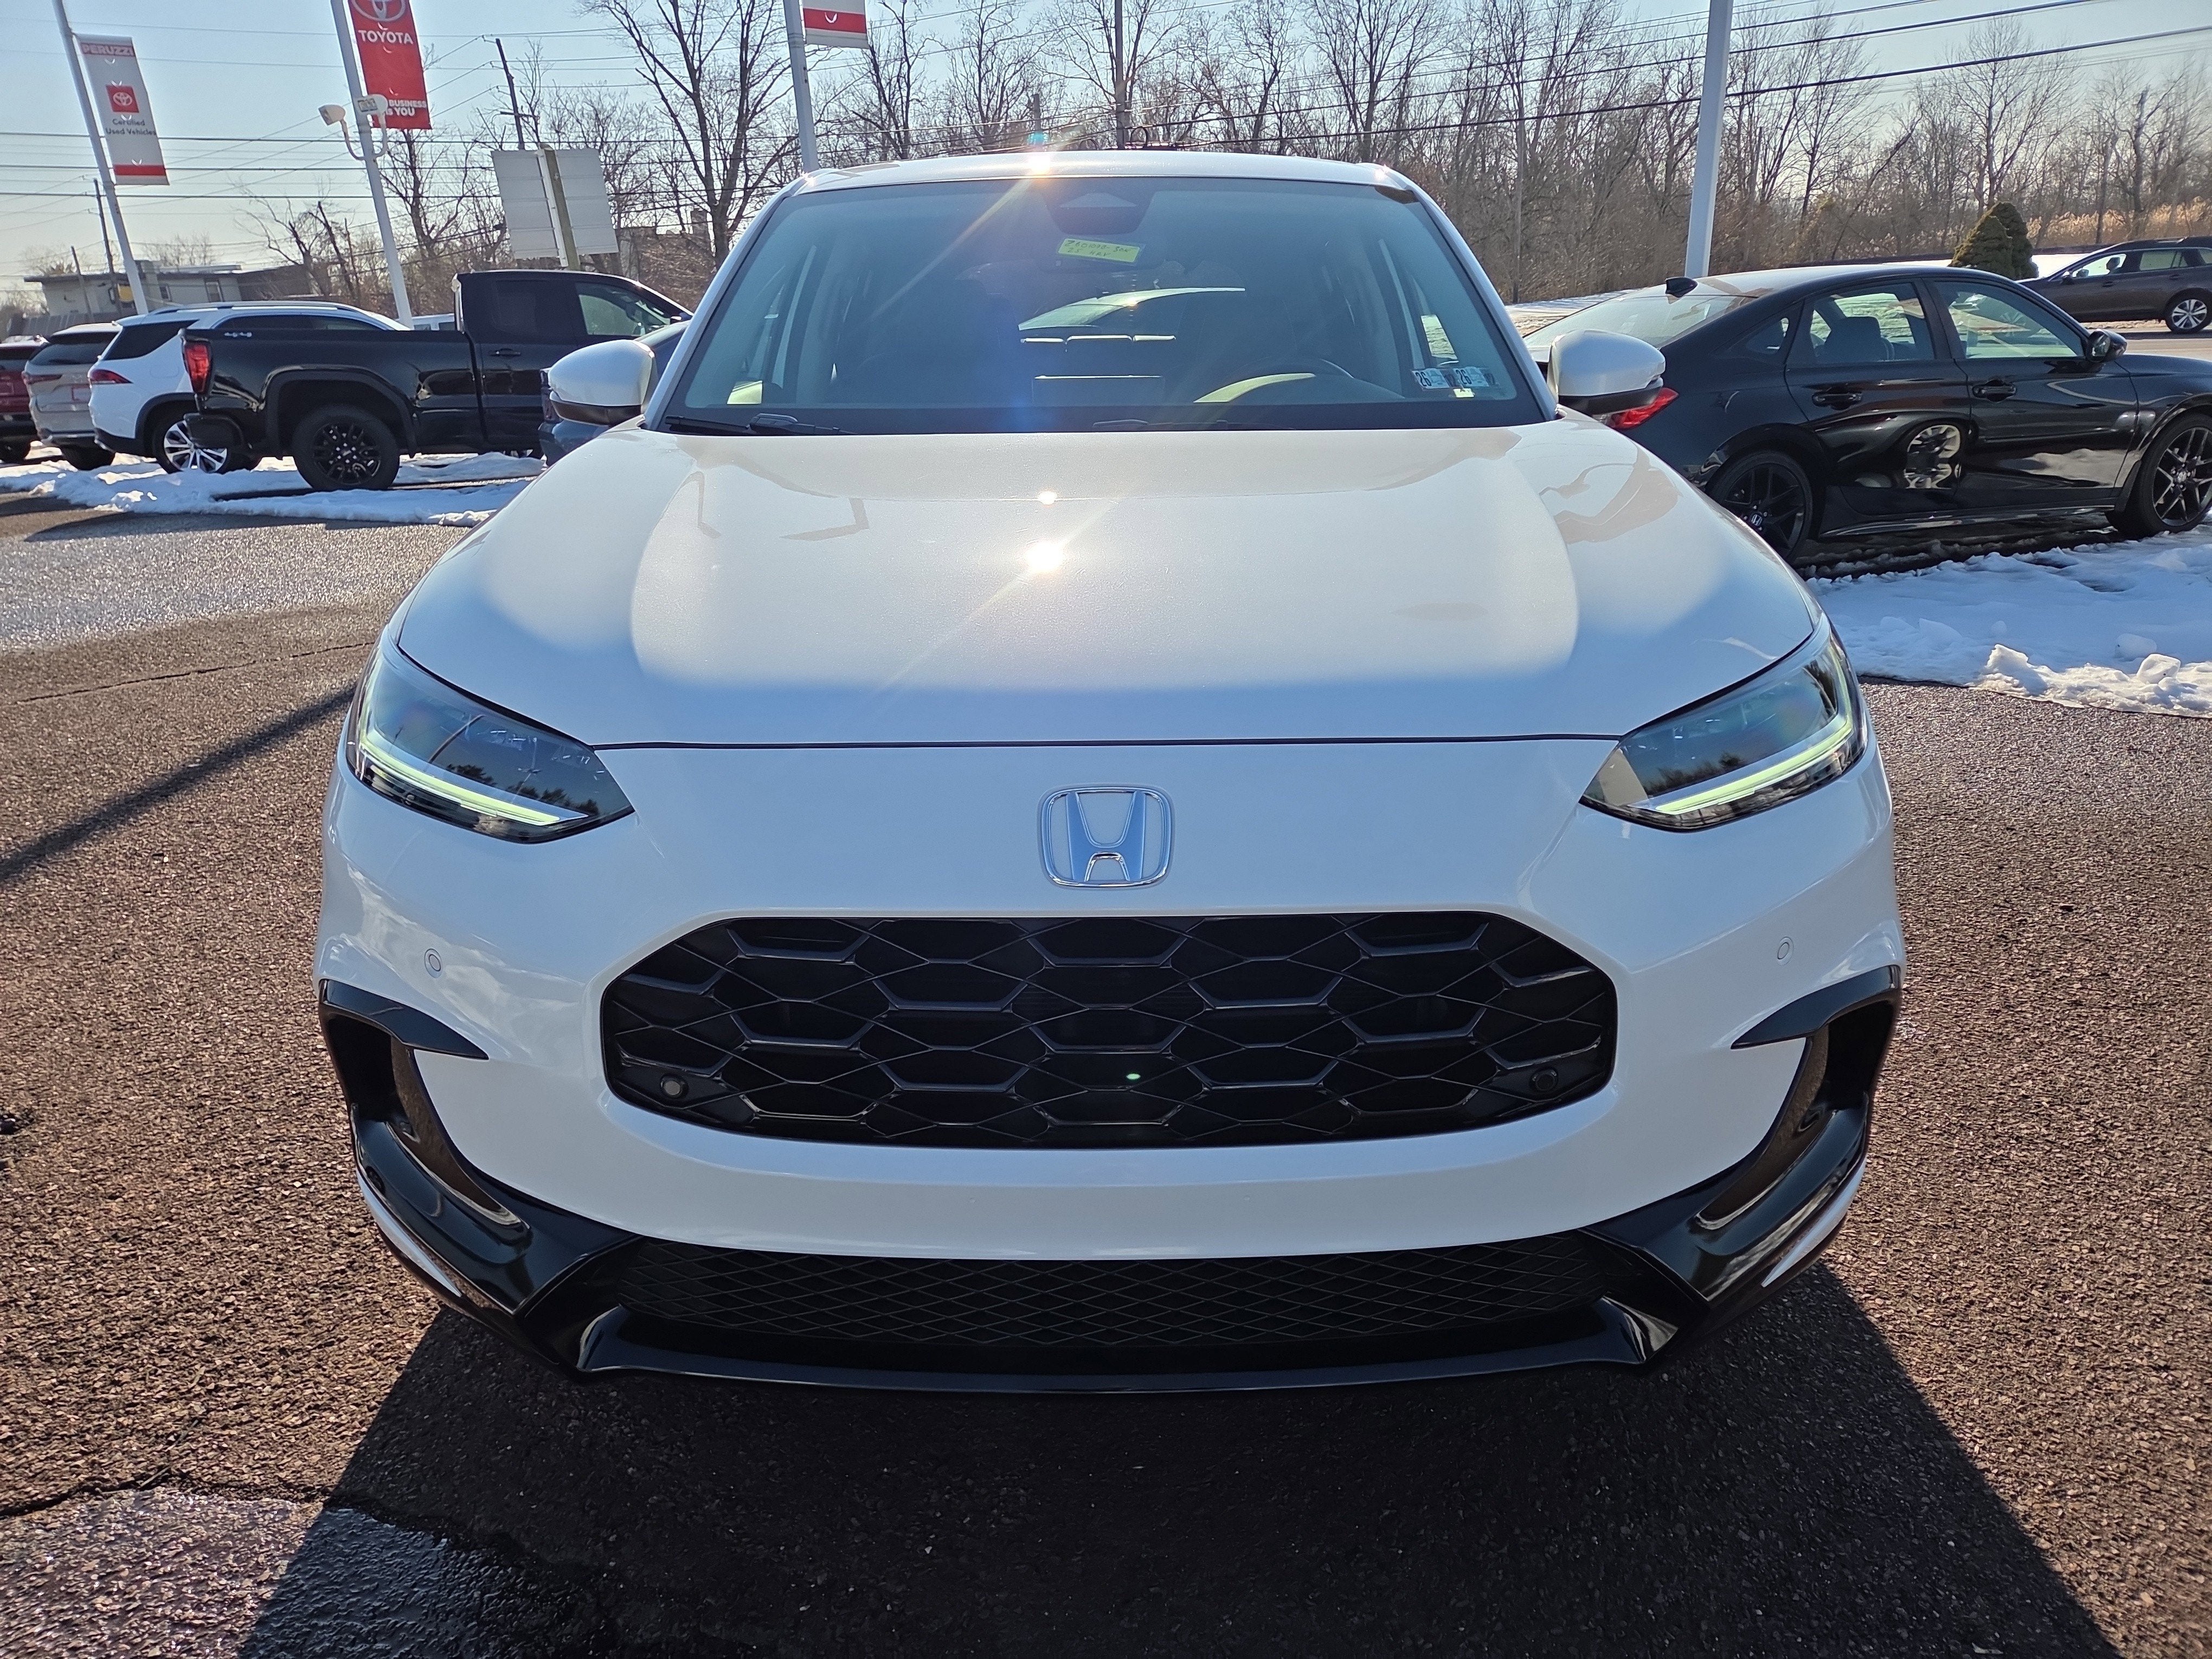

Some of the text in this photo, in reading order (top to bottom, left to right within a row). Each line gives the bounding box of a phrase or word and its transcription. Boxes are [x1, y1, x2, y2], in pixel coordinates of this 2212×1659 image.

[358, 30, 414, 44] TOYOTA
[81, 43, 135, 56] PERUZZI
[388, 99, 427, 108] BUSINESS
[394, 107, 415, 116] YOU
[1415, 372, 1432, 387] 26
[1455, 369, 1472, 384] 26
